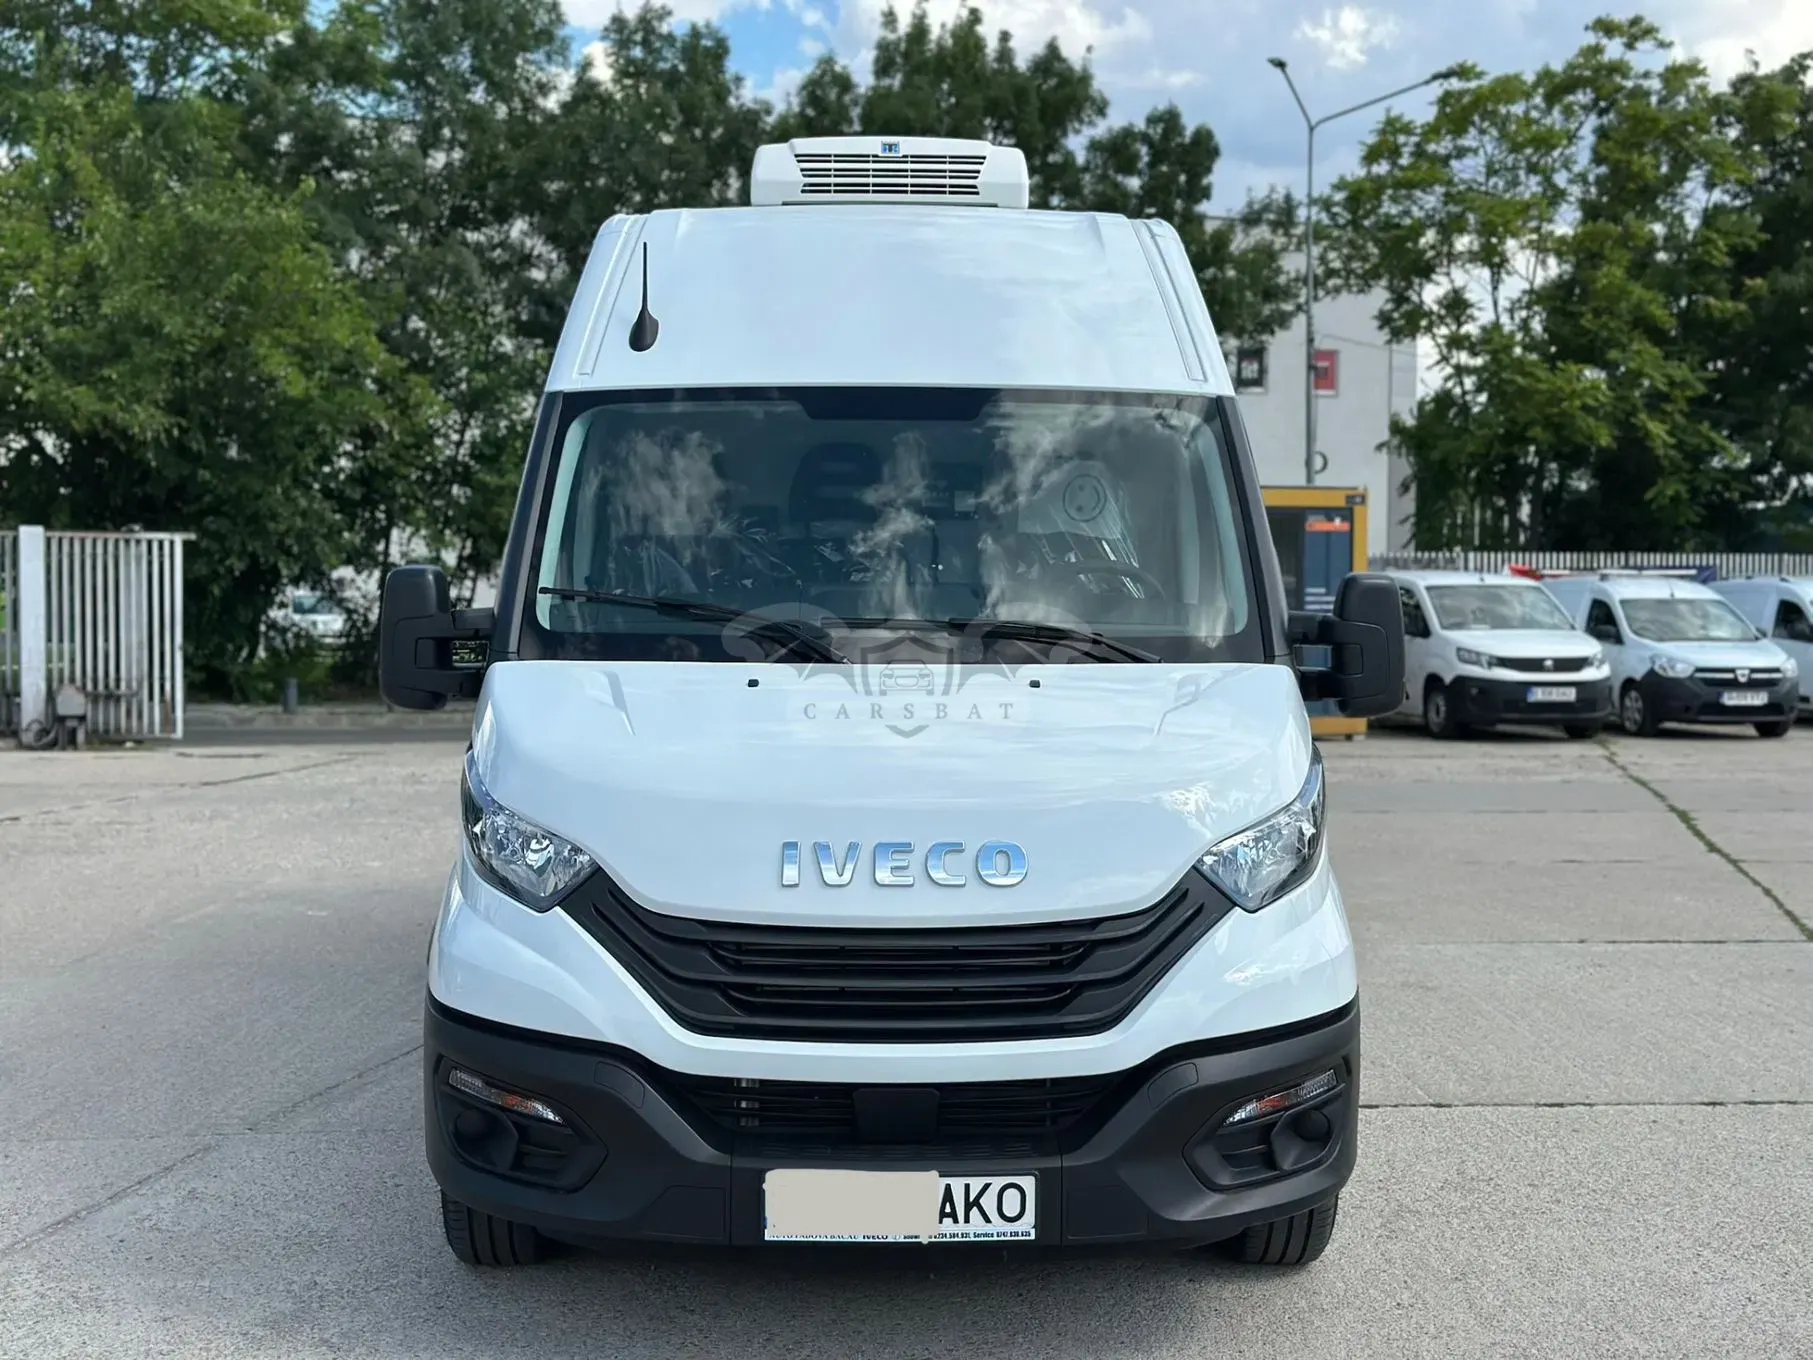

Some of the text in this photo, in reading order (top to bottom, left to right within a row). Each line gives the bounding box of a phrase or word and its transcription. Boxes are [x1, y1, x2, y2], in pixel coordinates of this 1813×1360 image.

[781, 840, 1029, 888] IVECO
[938, 1182, 1027, 1224] AKO
[973, 1231, 994, 1239] Service
